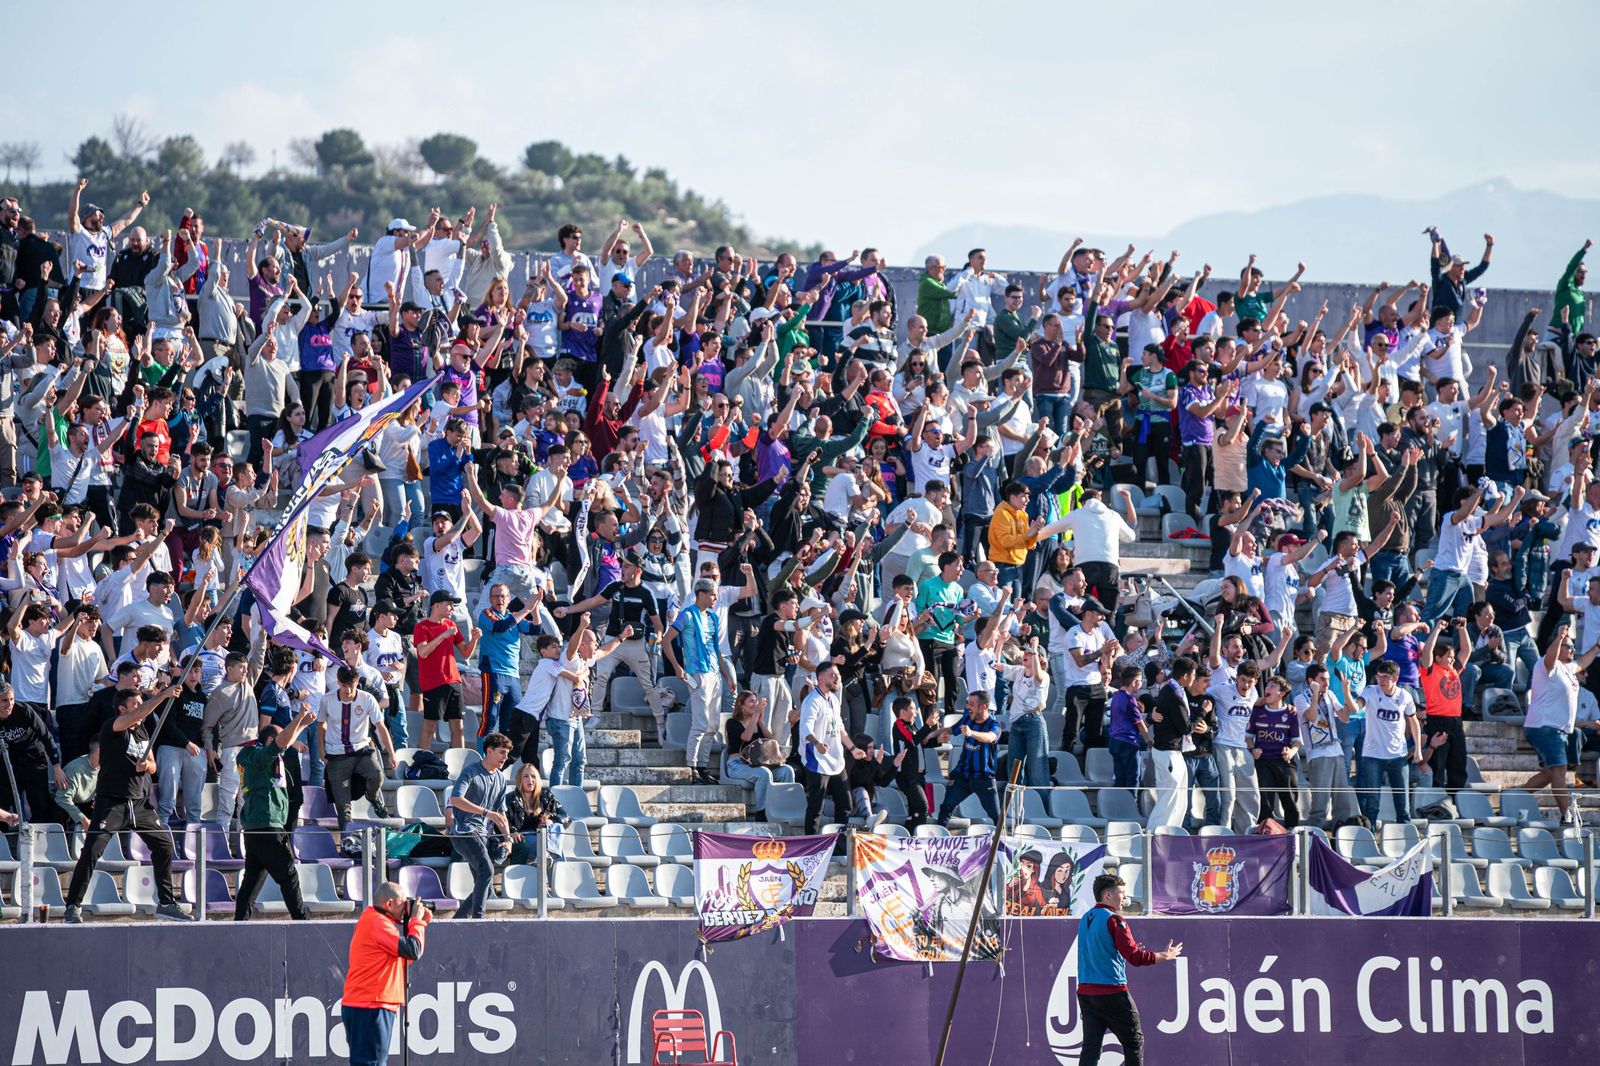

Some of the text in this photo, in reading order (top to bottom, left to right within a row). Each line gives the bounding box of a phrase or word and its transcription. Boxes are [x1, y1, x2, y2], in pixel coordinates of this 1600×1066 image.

[11, 981, 516, 1066] McDond's
[1156, 955, 1554, 1034] Jaén Clima
